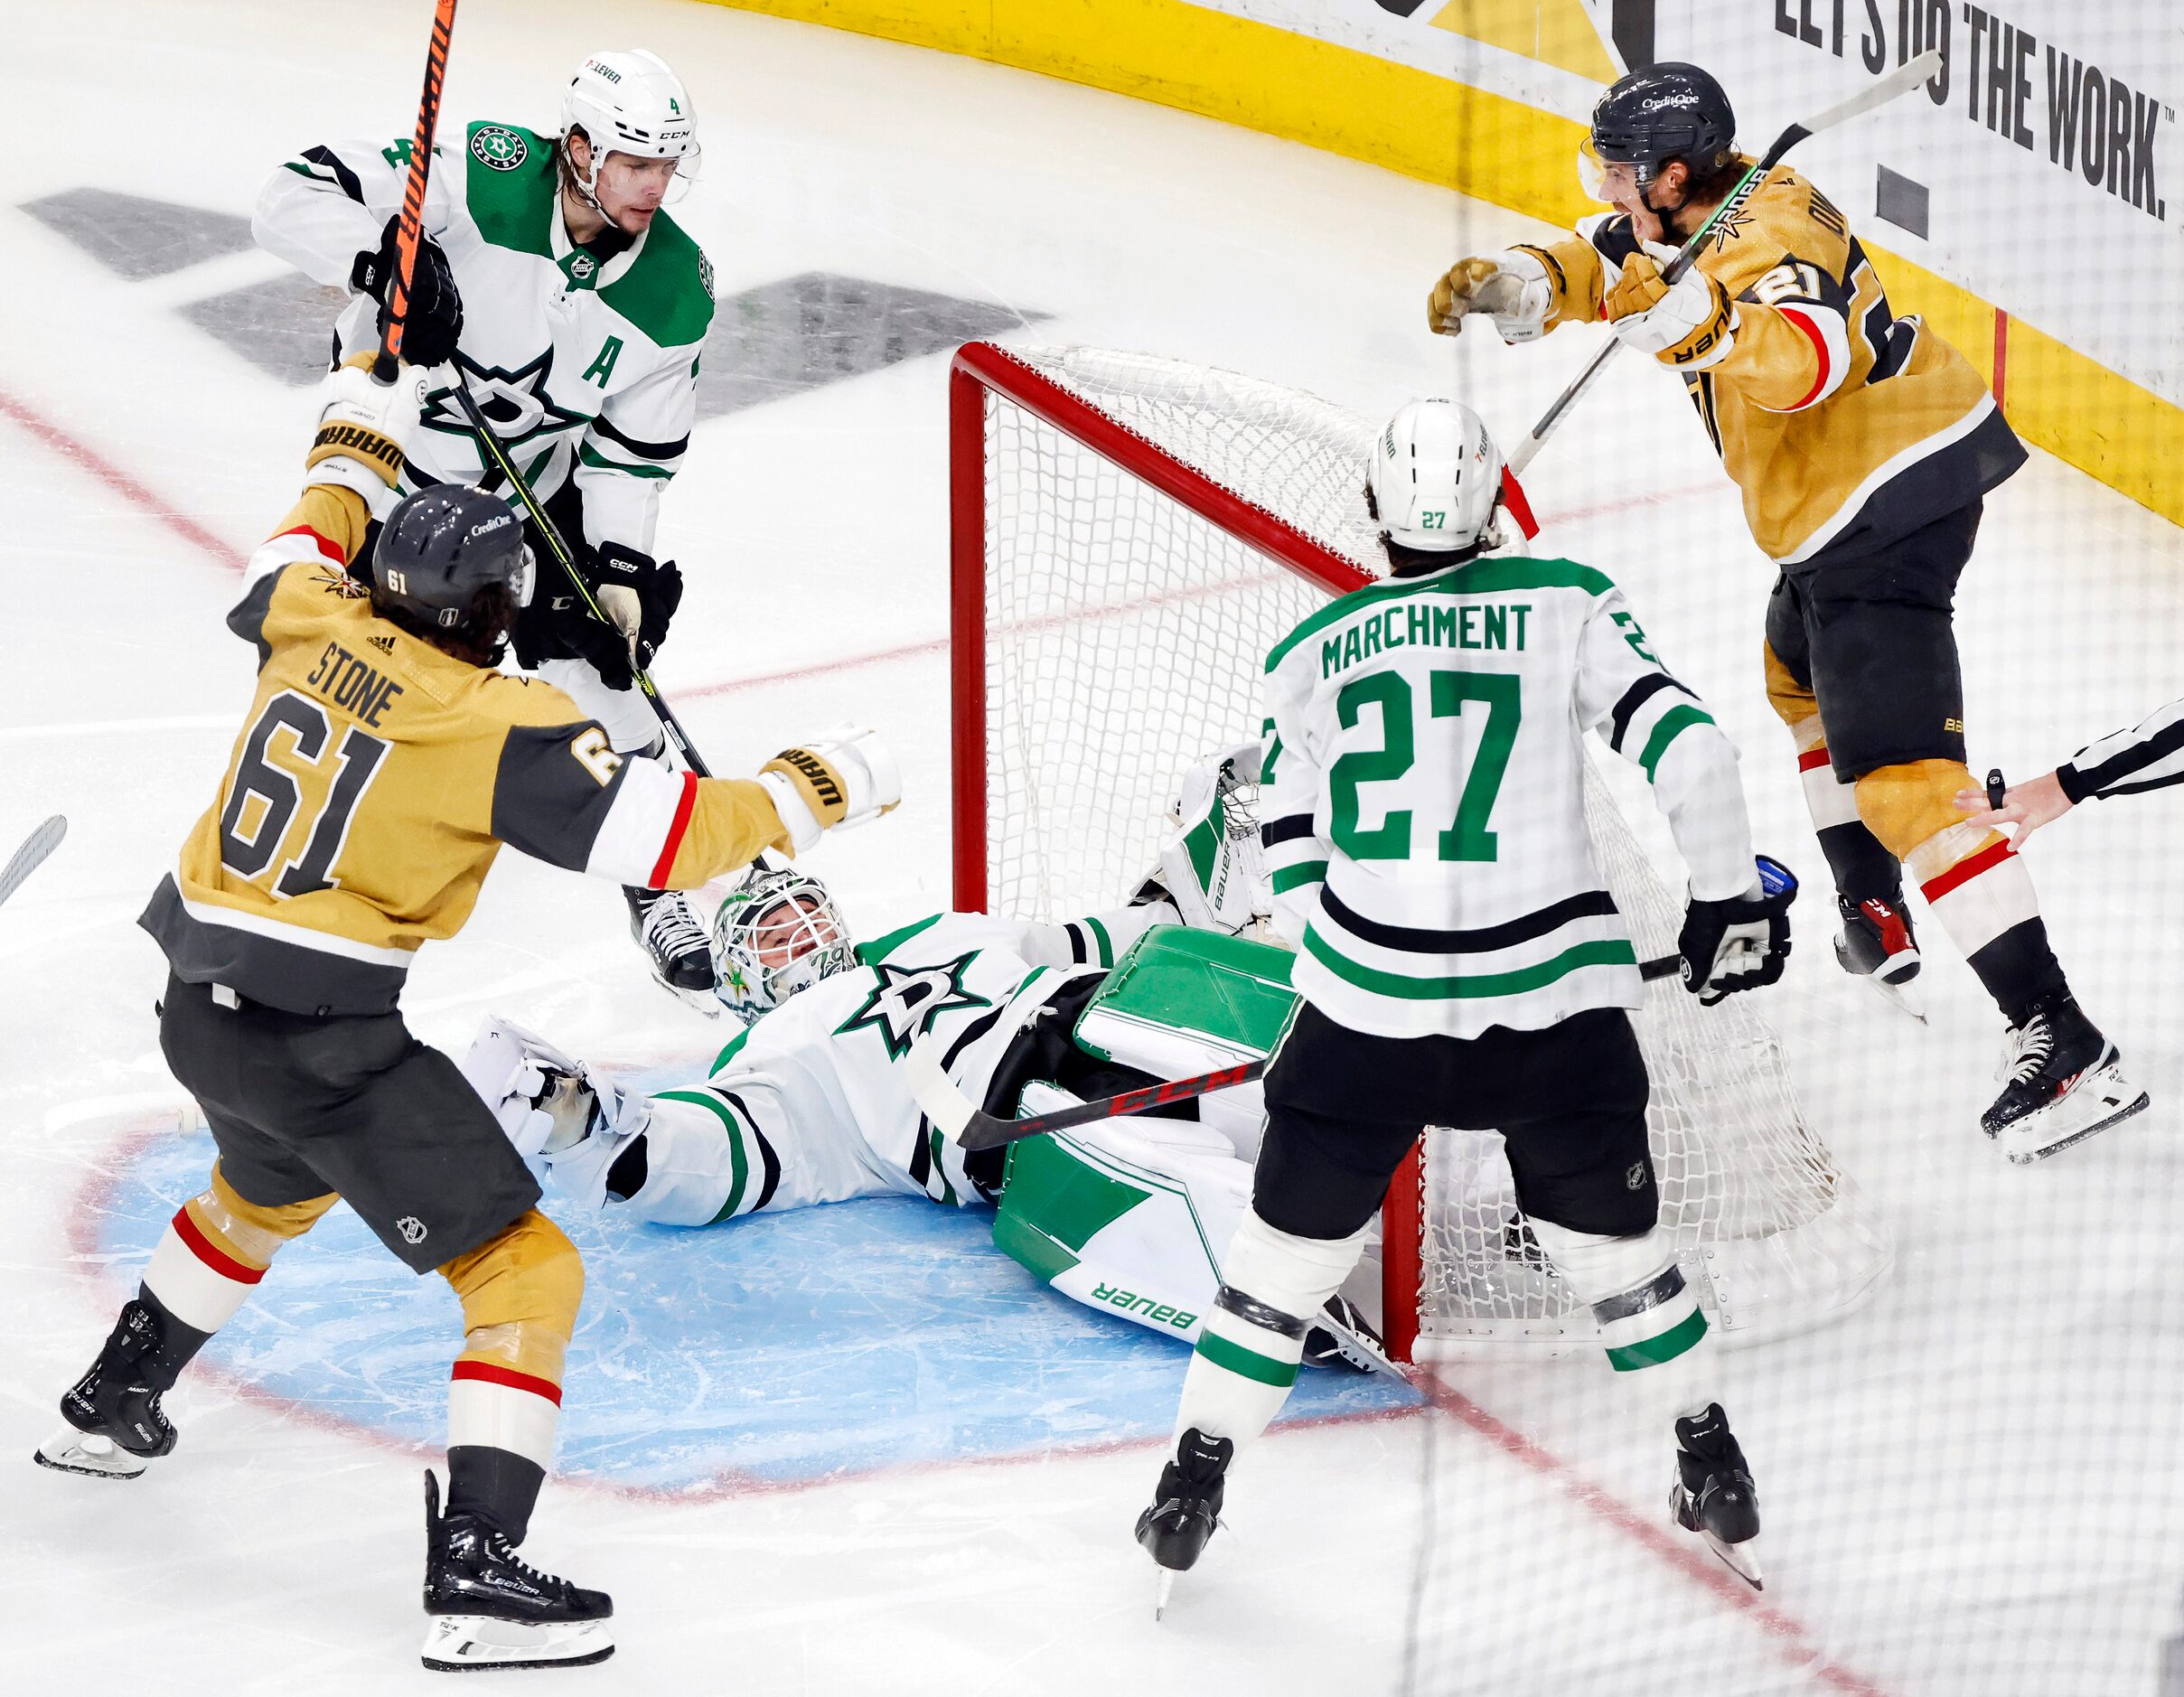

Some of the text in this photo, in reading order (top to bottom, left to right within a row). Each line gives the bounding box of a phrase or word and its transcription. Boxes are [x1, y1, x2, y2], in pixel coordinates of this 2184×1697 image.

[670, 98, 680, 115] 4
[1964, 3, 2036, 151] THE
[2046, 44, 2166, 222] WORK.
[660, 130, 690, 140] CCM
[1750, 262, 1823, 305] 21
[581, 334, 623, 389] A
[1422, 511, 1446, 529] 27
[387, 568, 408, 595] 61
[609, 558, 639, 571] CCM
[1322, 605, 1533, 680] MARCHMENT
[307, 641, 404, 728] STONE
[1330, 670, 1522, 862] 27
[220, 687, 395, 900] 61
[1109, 1063, 1250, 1116] CCM
[1091, 1281, 1198, 1330] BAUER
